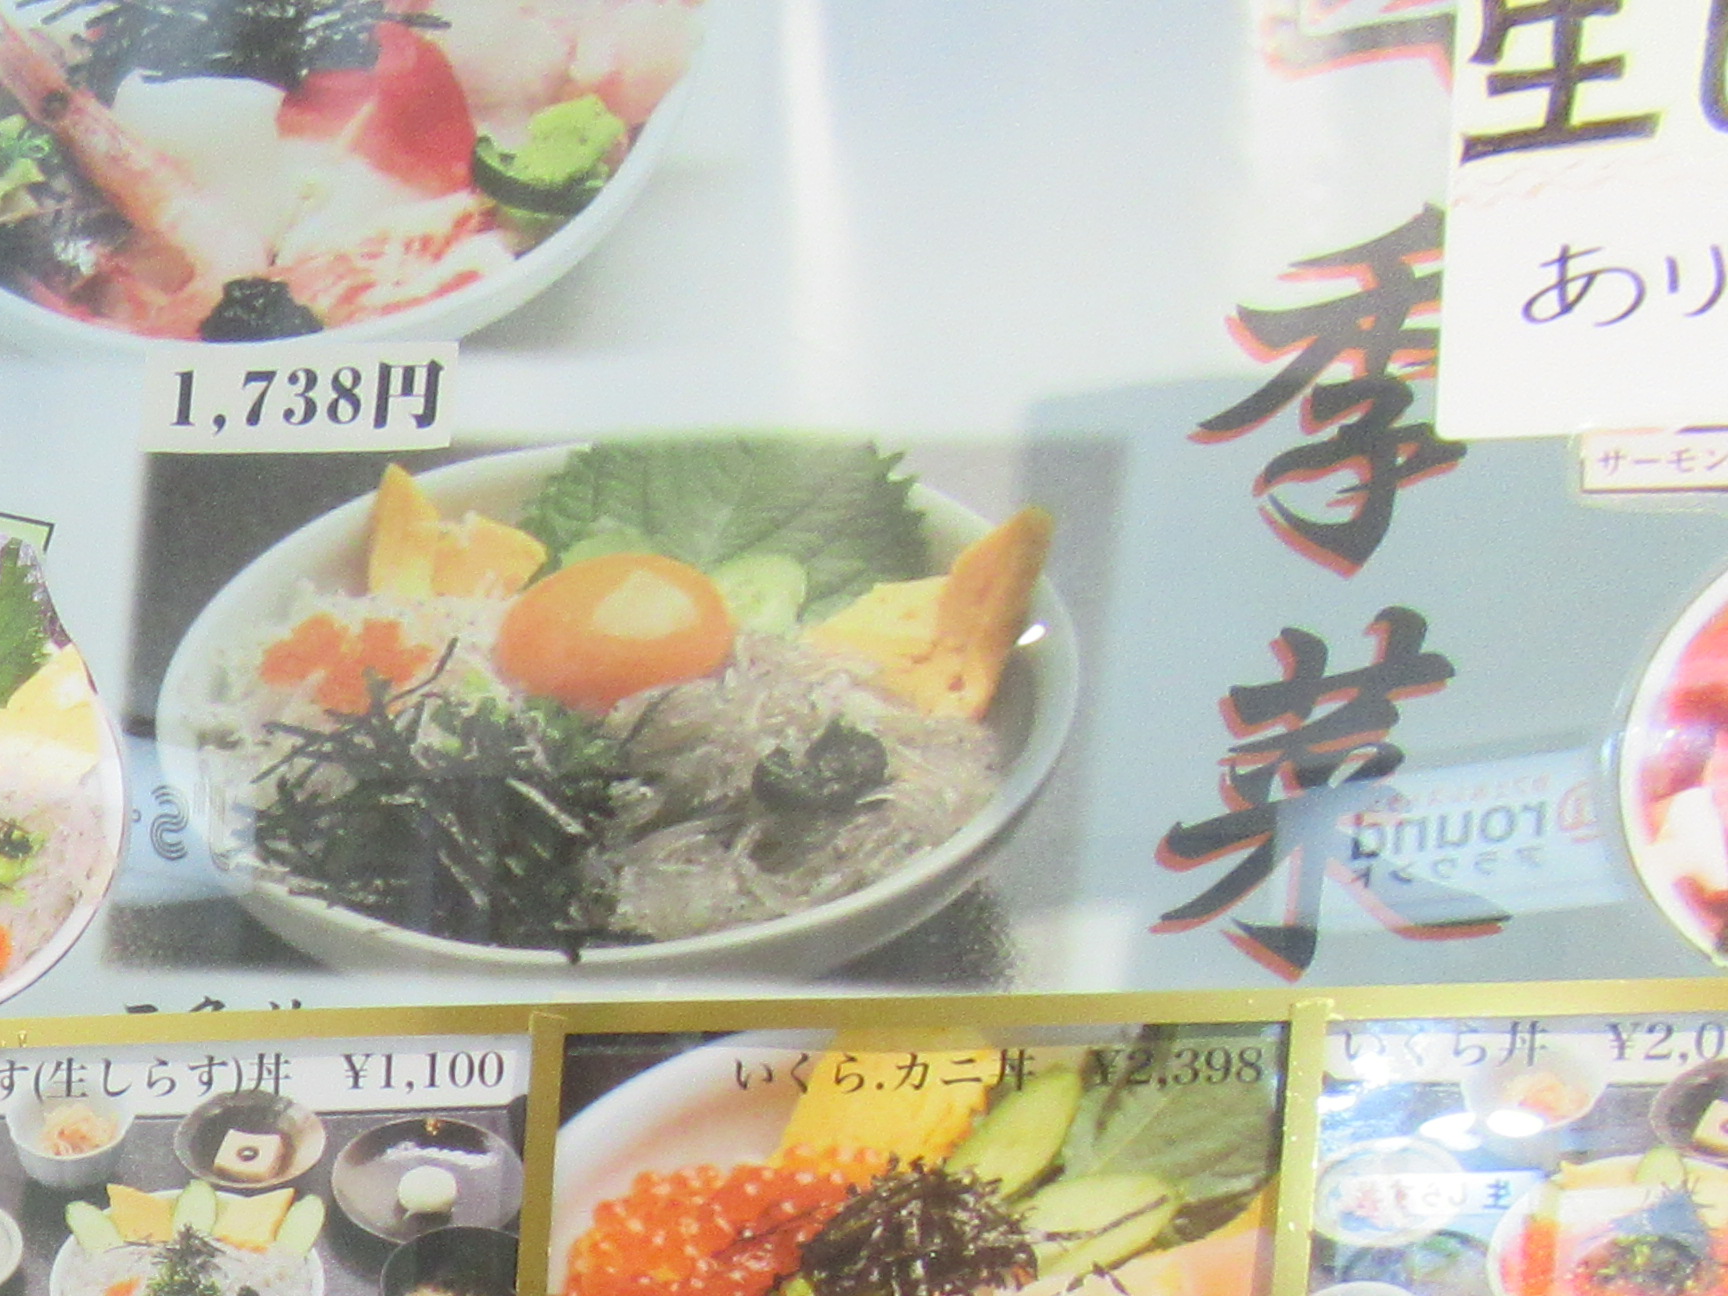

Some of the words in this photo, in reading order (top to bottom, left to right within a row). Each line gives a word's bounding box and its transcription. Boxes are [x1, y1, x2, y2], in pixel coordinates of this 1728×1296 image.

[168, 357, 445, 432] 1,738円
[1148, 0, 1513, 984] 季菜
[342, 1050, 505, 1095] ¥1,100
[1089, 1046, 1266, 1089] ¥2,398
